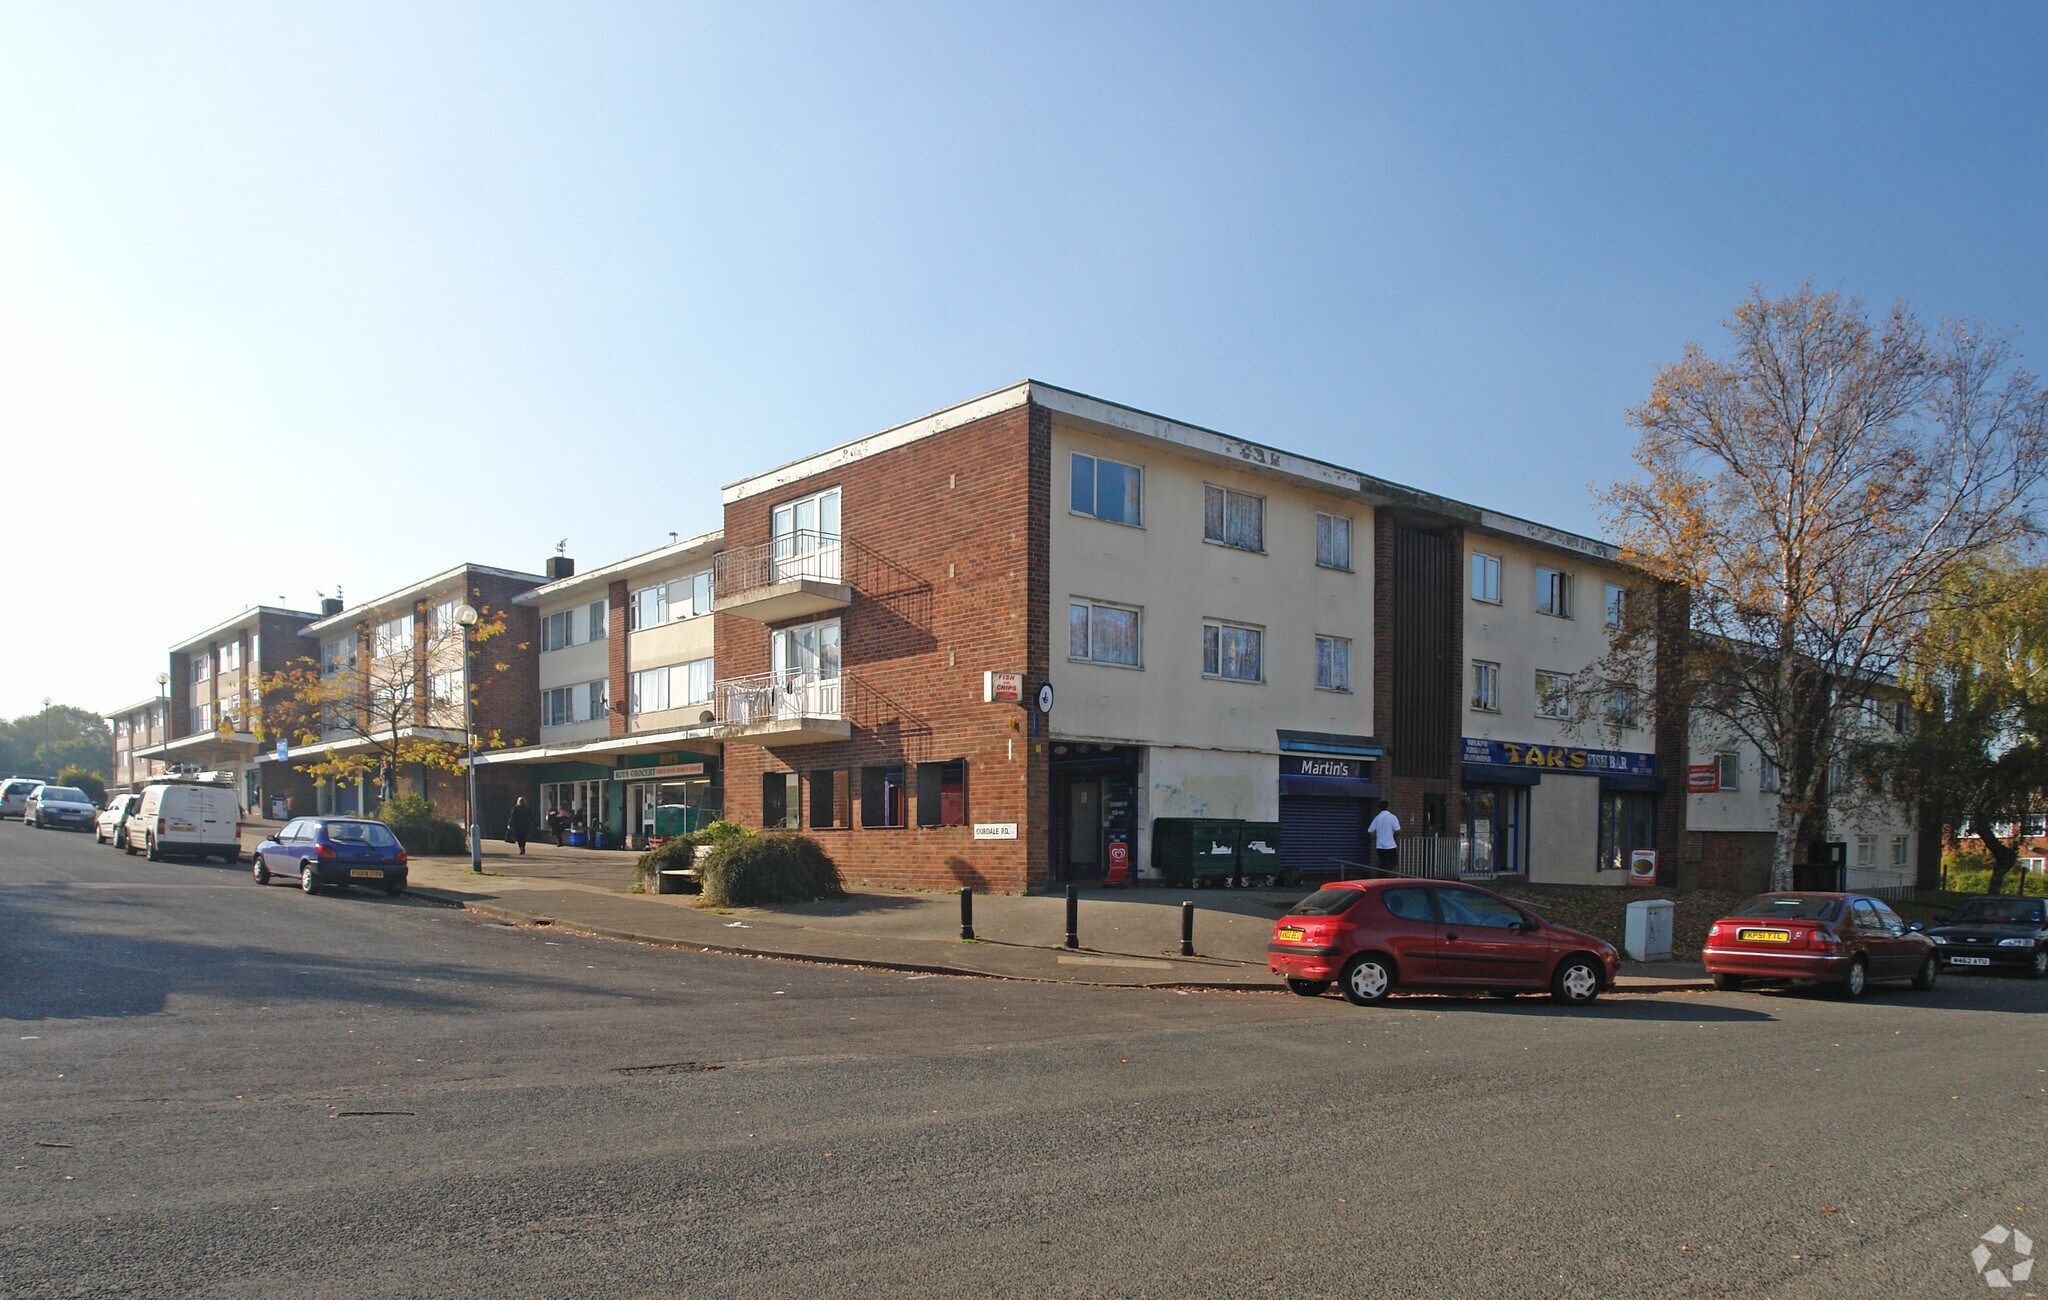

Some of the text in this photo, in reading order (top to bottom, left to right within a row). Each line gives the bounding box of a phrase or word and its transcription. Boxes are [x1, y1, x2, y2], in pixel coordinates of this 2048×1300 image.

[1503, 743, 1628, 770] TAK'S FISH BAR
[1301, 760, 1349, 776] Martin's
